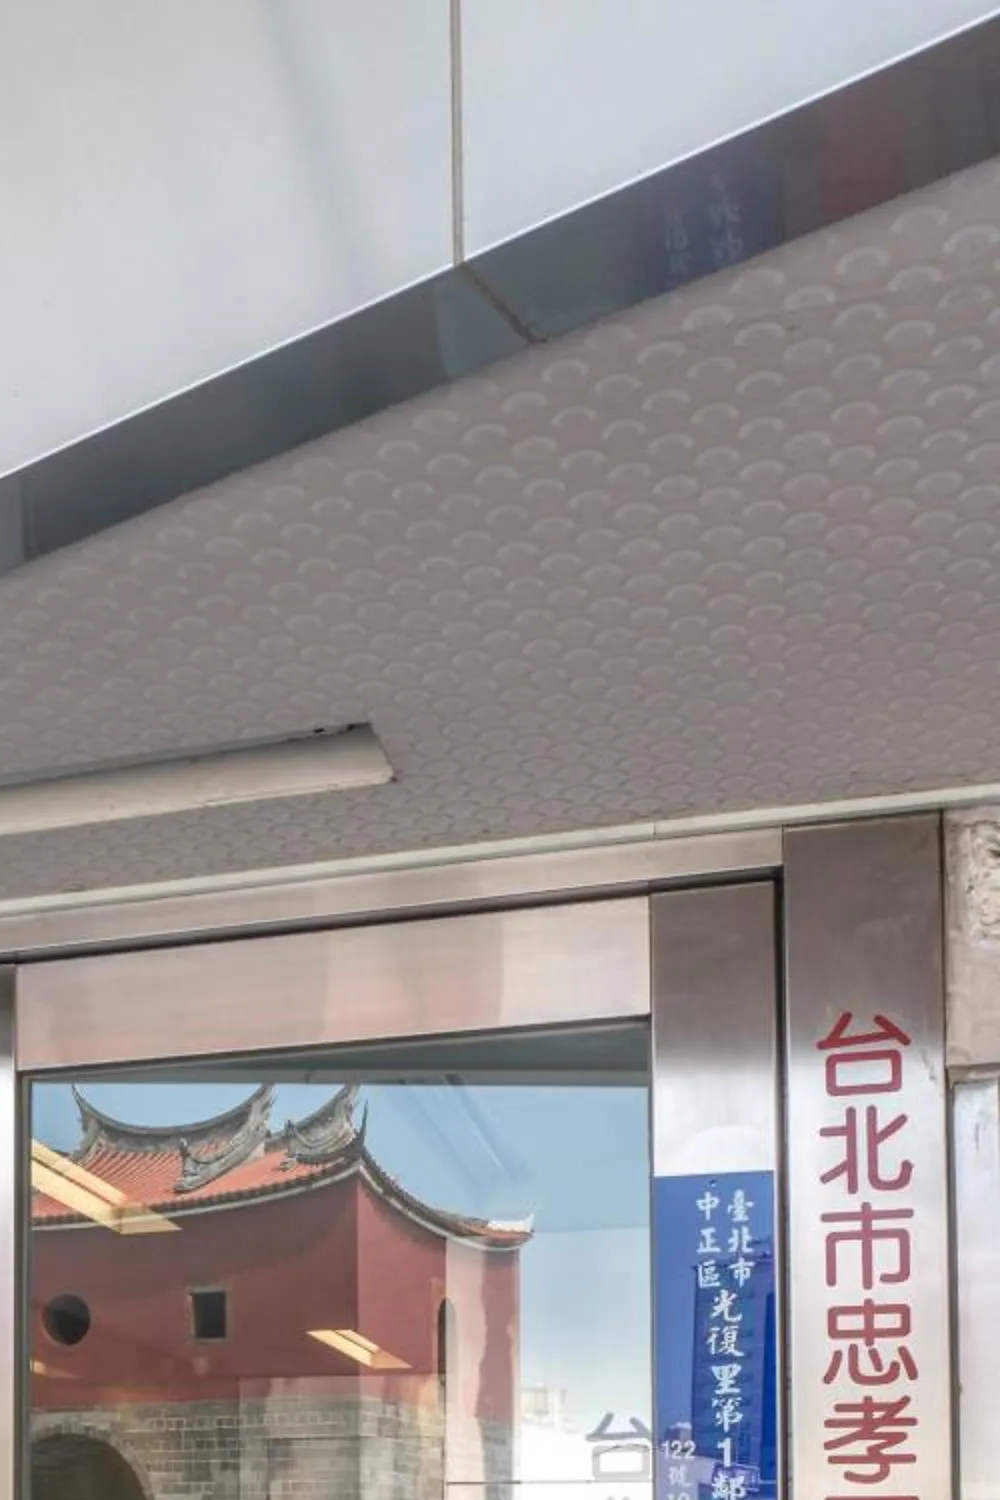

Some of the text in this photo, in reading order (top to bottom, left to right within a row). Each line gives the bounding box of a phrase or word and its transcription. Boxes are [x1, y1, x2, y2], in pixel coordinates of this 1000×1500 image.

[696, 1191, 721, 1288] 中正區
[727, 1189, 757, 1288] 臺北市
